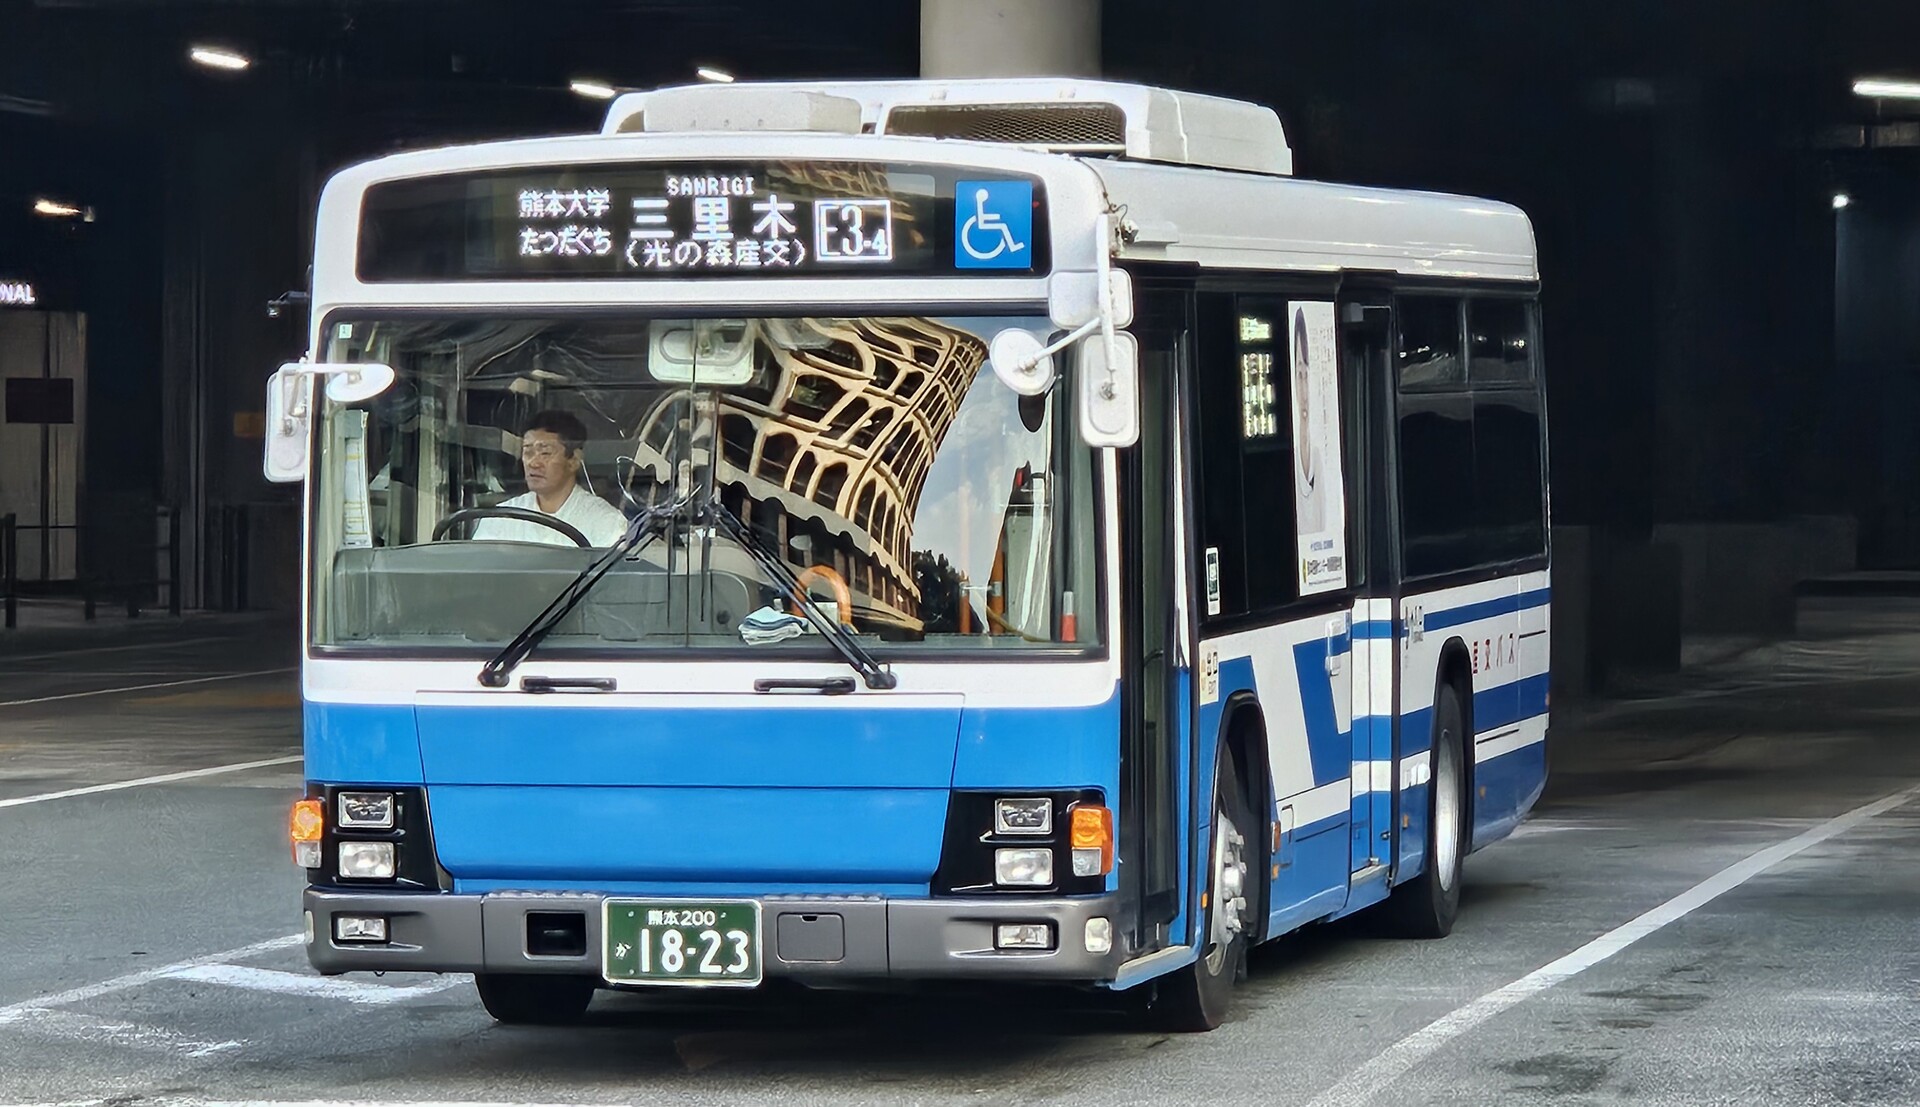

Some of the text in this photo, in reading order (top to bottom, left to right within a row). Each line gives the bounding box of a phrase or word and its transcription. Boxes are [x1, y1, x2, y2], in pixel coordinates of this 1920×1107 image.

[666, 176, 755, 196] SANRIGI
[519, 188, 611, 218] 熊本大学
[629, 194, 797, 241] 三里木
[519, 225, 612, 256] たつだぐち
[641, 928, 749, 974] 18-23
